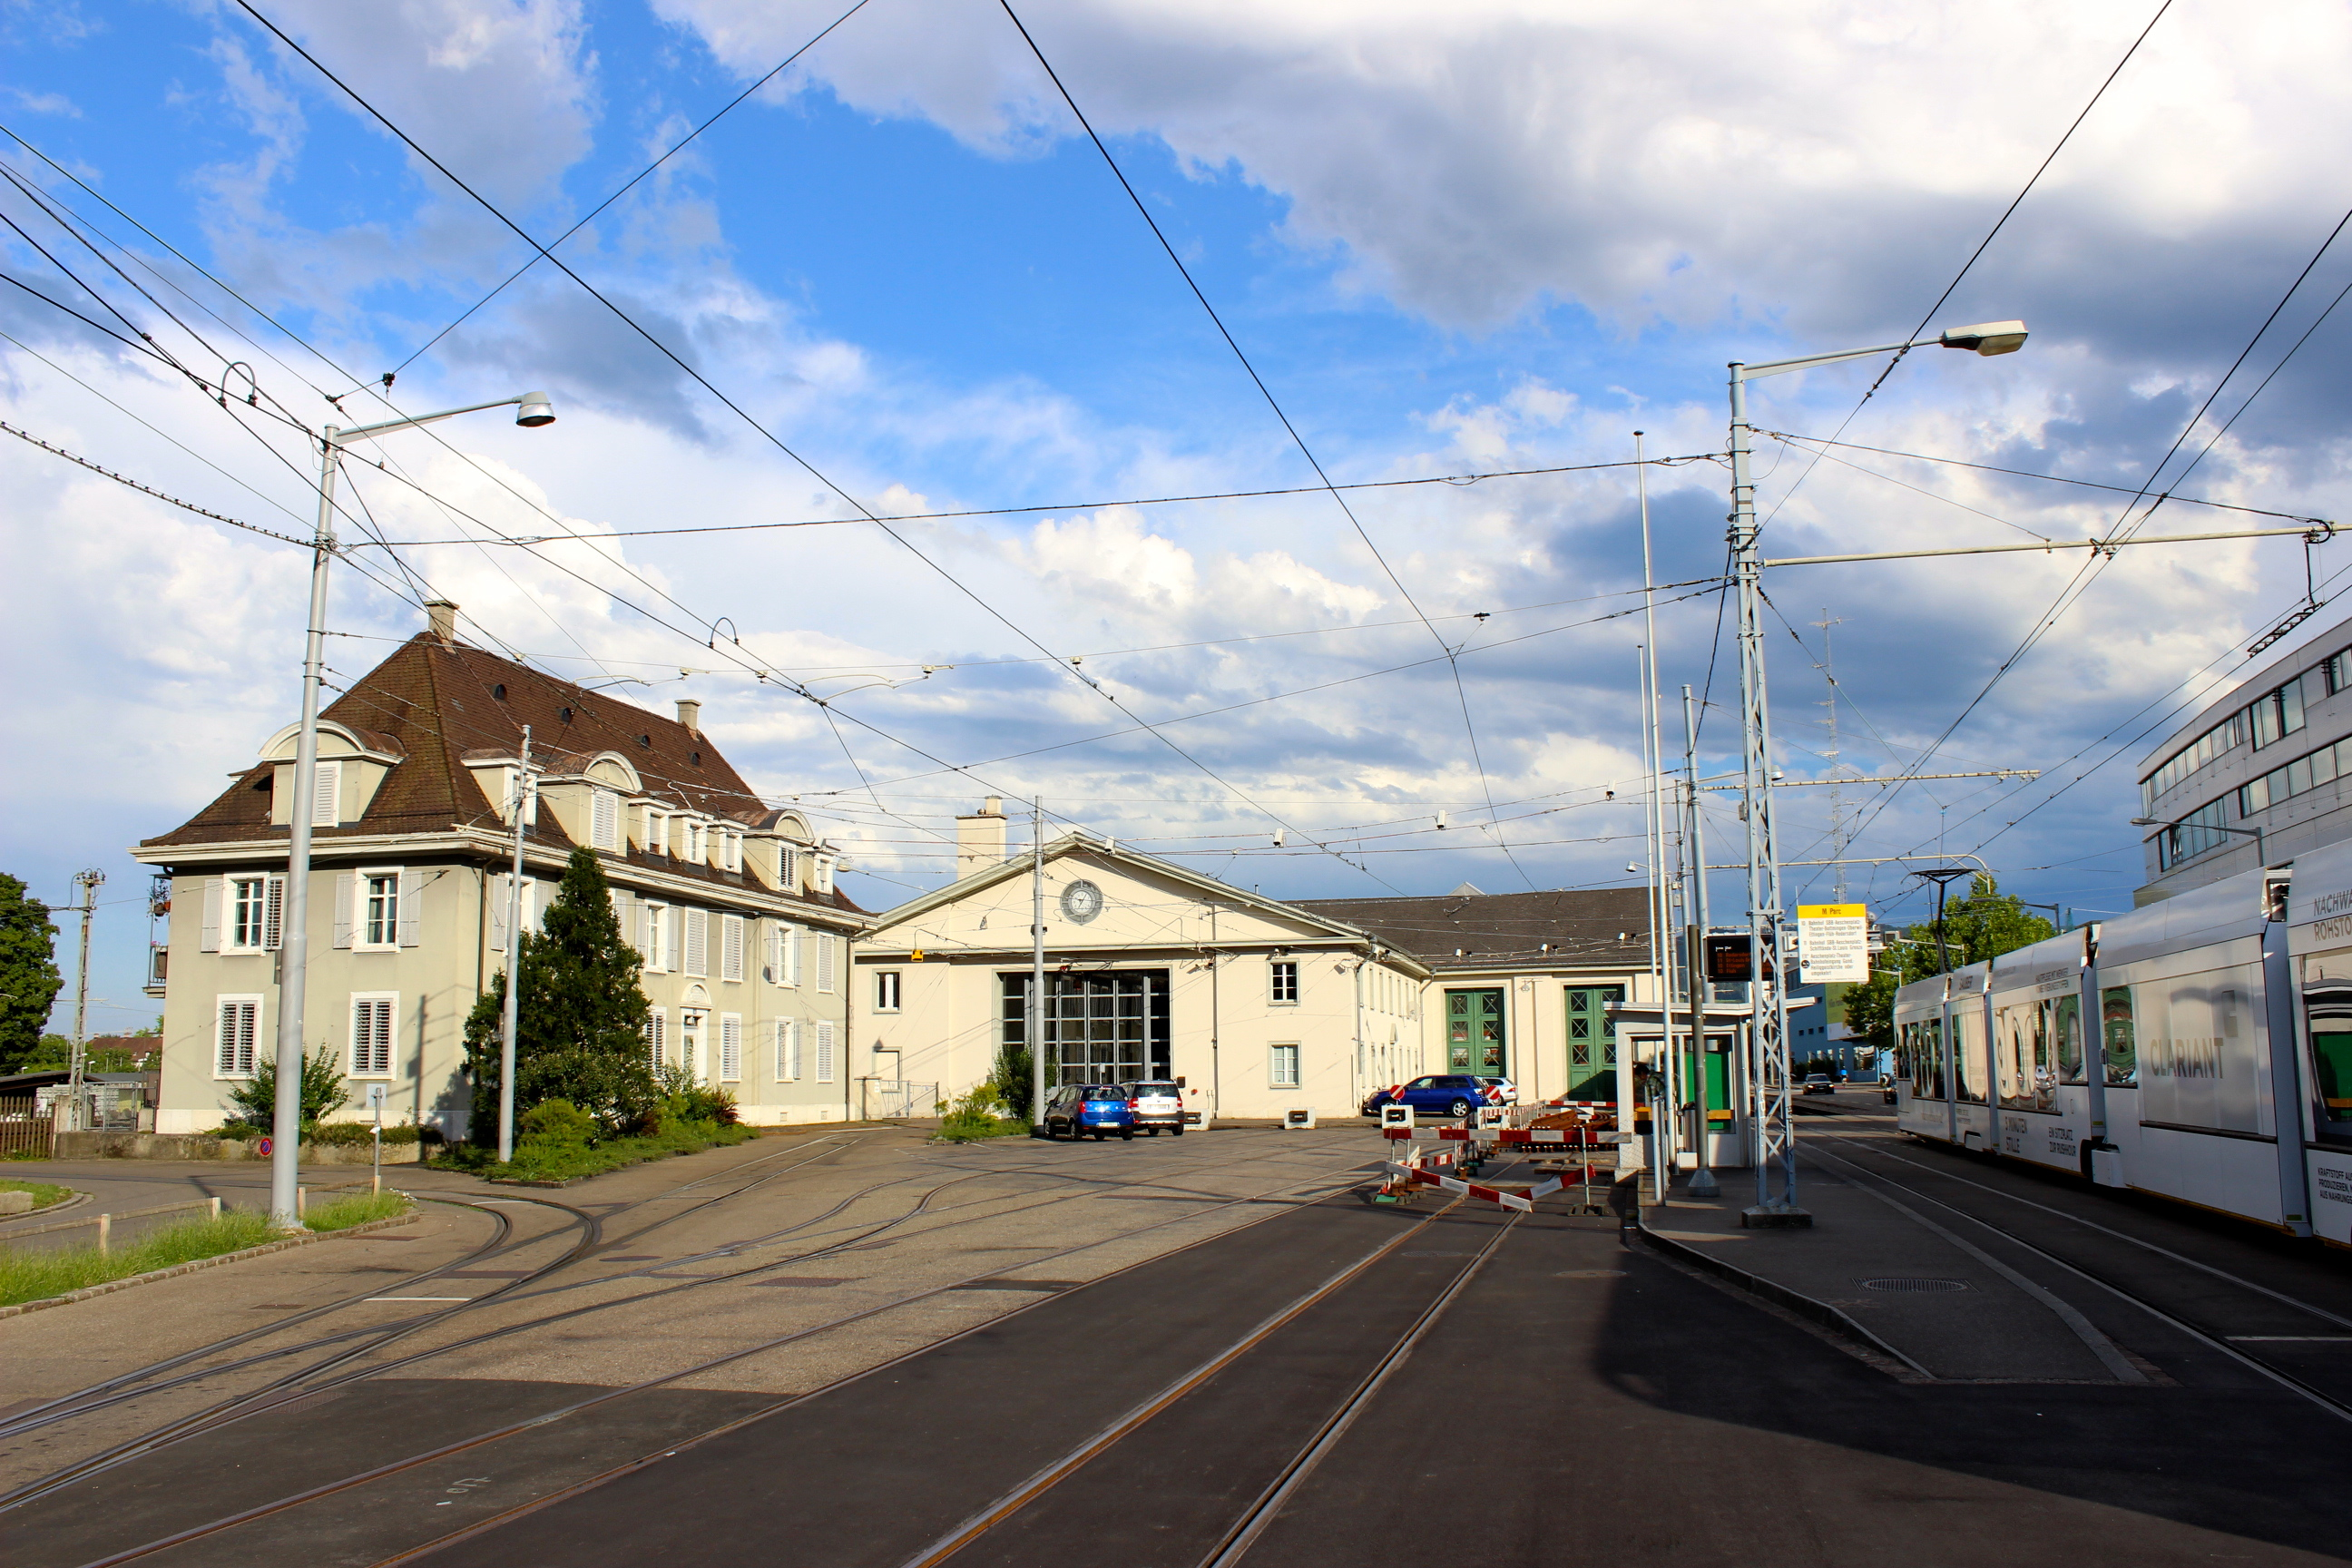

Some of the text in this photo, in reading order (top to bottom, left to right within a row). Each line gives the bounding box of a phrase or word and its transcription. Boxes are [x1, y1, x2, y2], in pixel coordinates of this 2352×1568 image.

[2313, 916, 2352, 942] ROHSTO
[2151, 1037, 2224, 1079] CLARIANT
[2318, 1167, 2344, 1180] KRAFTSTOFF
